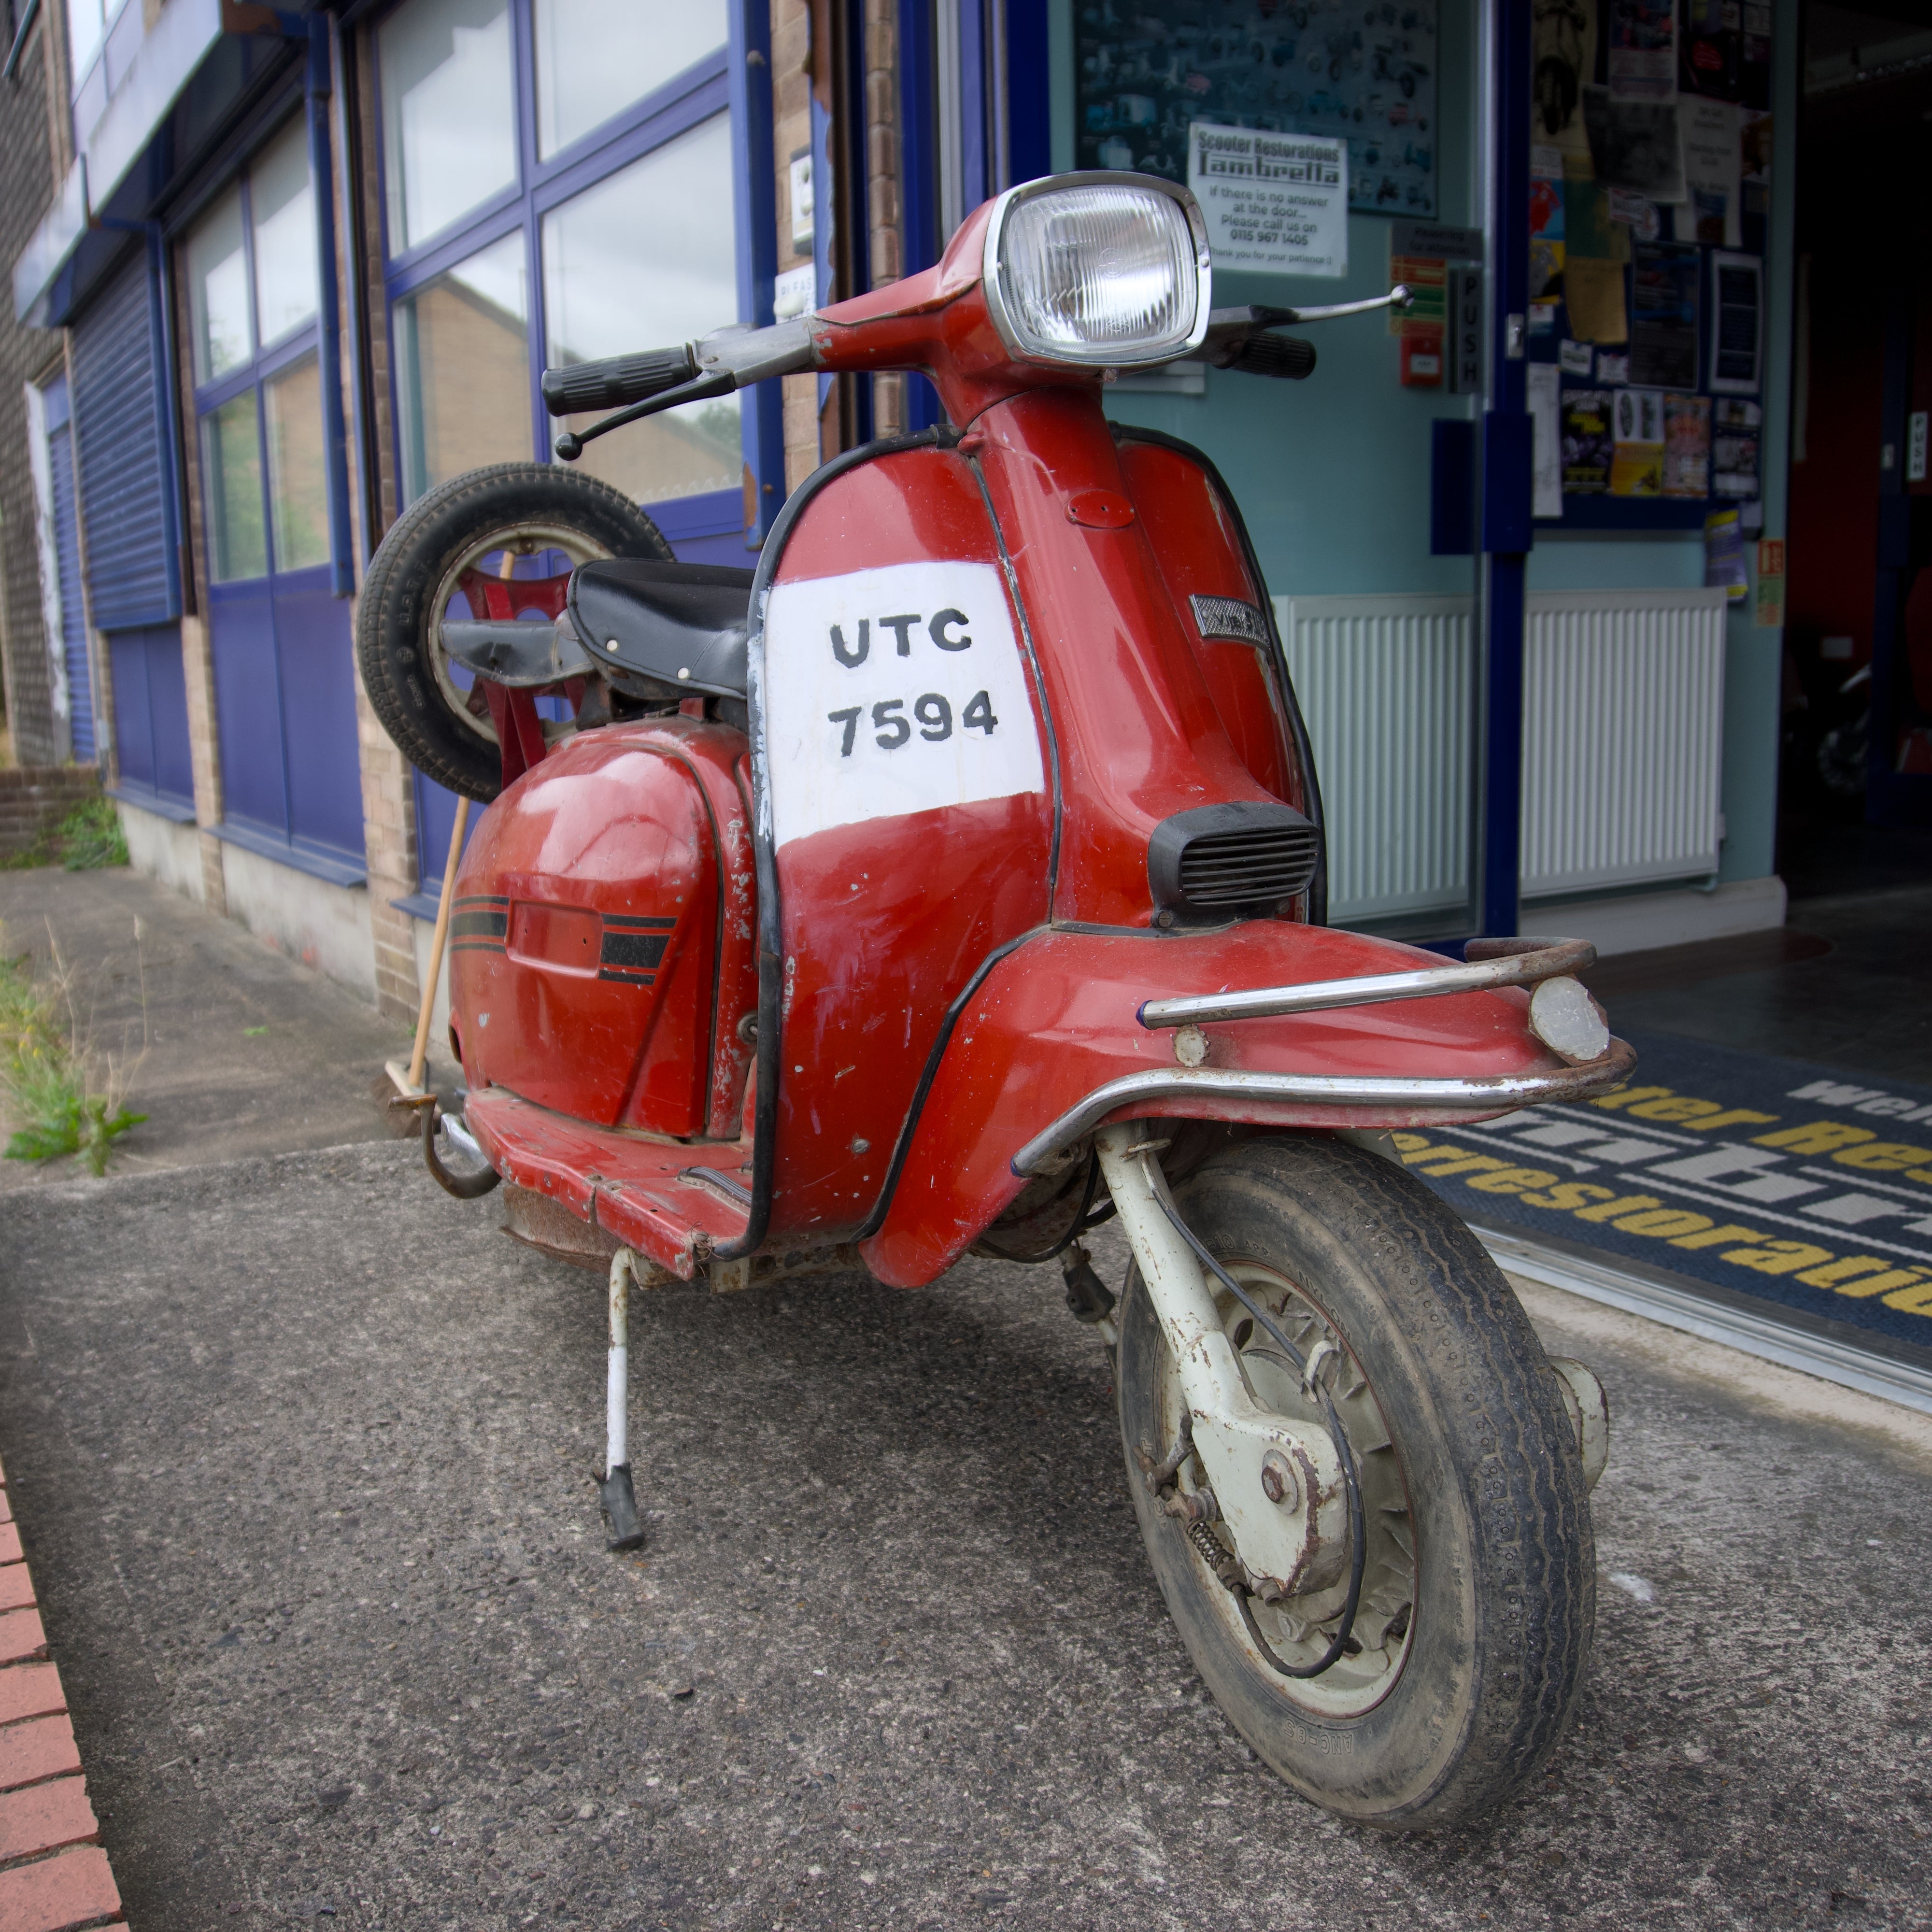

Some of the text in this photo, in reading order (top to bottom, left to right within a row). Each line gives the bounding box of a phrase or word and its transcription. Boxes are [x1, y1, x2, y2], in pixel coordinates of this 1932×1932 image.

[1198, 130, 1339, 163] Scooter Restorations
[1210, 185, 1329, 207] If there is no answer
[1234, 202, 1245, 213] at
[1249, 203, 1268, 215] the
[1221, 213, 1317, 233] Please call us on
[1230, 228, 1308, 246] 0115 967 1405
[1209, 246, 1233, 257] Thank
[1235, 250, 1251, 259] you
[1253, 250, 1265, 259] for
[1267, 253, 1287, 262] your
[1289, 253, 1325, 264] patience
[1464, 275, 1478, 383] PUSH
[829, 608, 972, 669] UTC
[827, 690, 998, 757] 7594
[1590, 1085, 1782, 1131] ter
